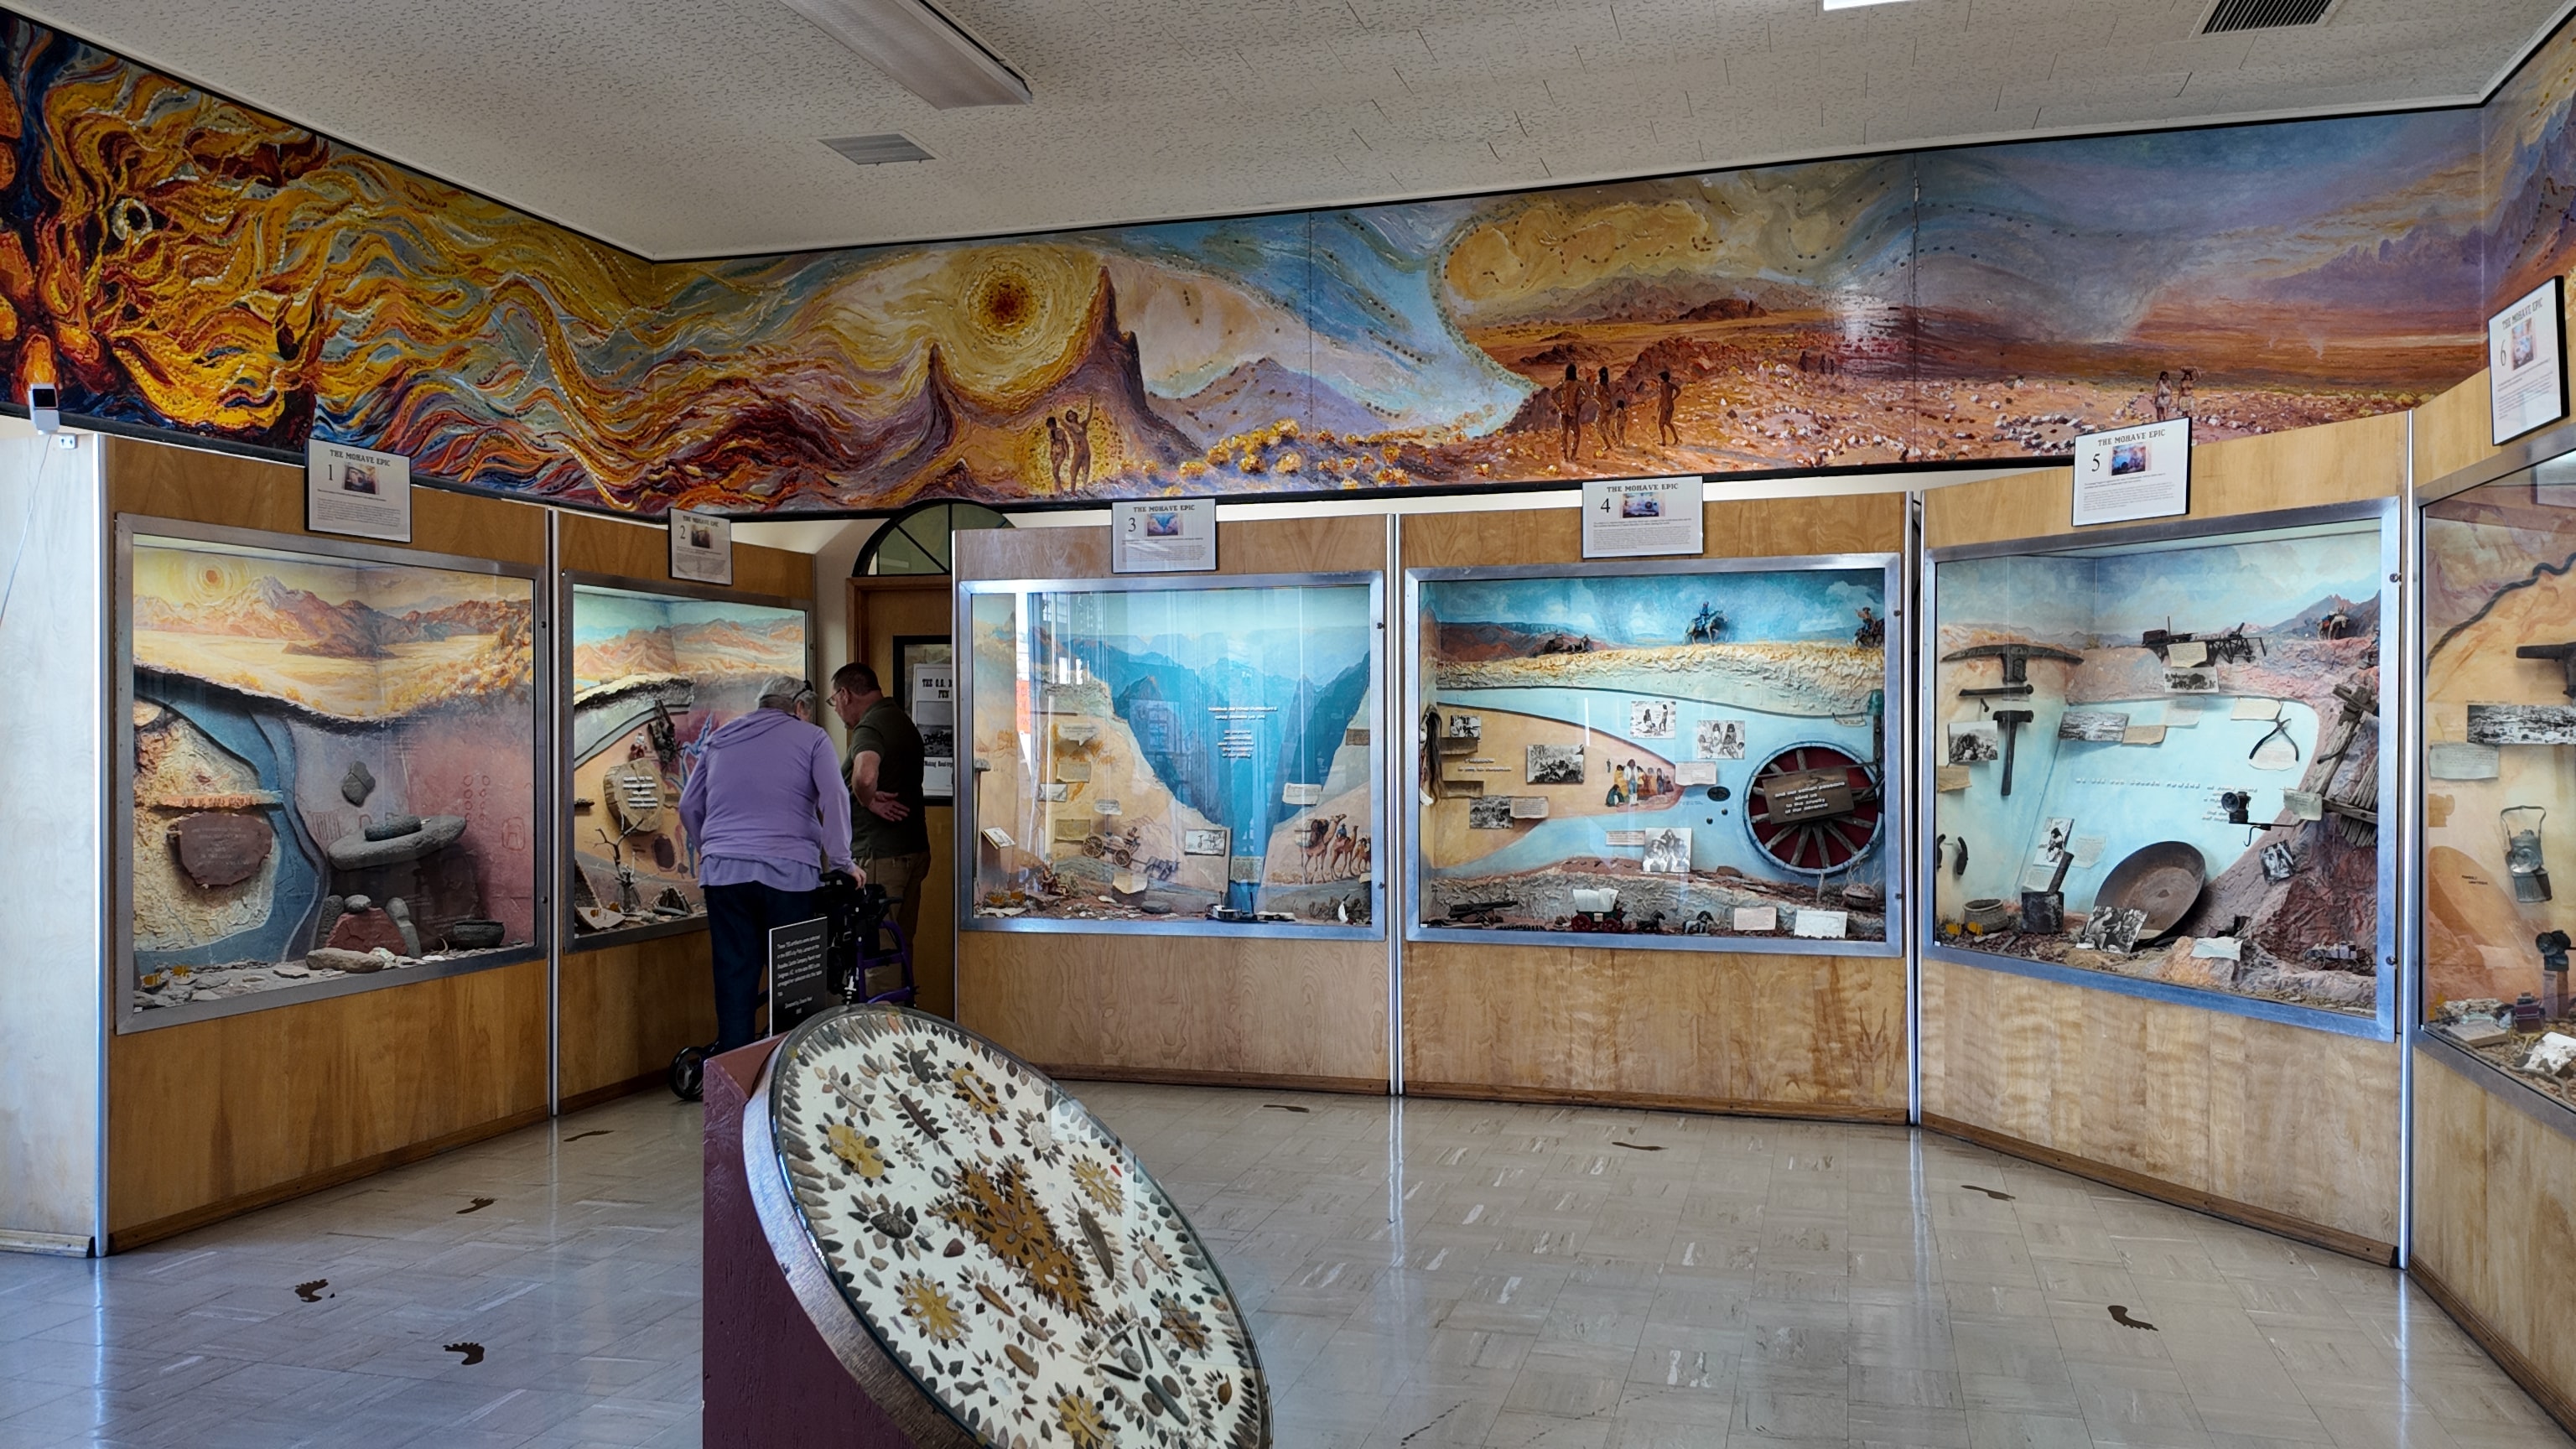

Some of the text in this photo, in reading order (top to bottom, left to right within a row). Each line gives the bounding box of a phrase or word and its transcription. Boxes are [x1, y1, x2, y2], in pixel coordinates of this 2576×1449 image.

[2500, 339, 2506, 366] 6
[2098, 428, 2166, 446] THE MOHAVE EPIC
[330, 449, 391, 467] THE MOHAVE EPIC
[2091, 453, 2101, 472] 5
[328, 464, 334, 481] 1
[1661, 482, 1679, 491] EPIC
[1600, 498, 1611, 513] 4
[679, 525, 686, 540] 2
[1128, 517, 1136, 532] 3
